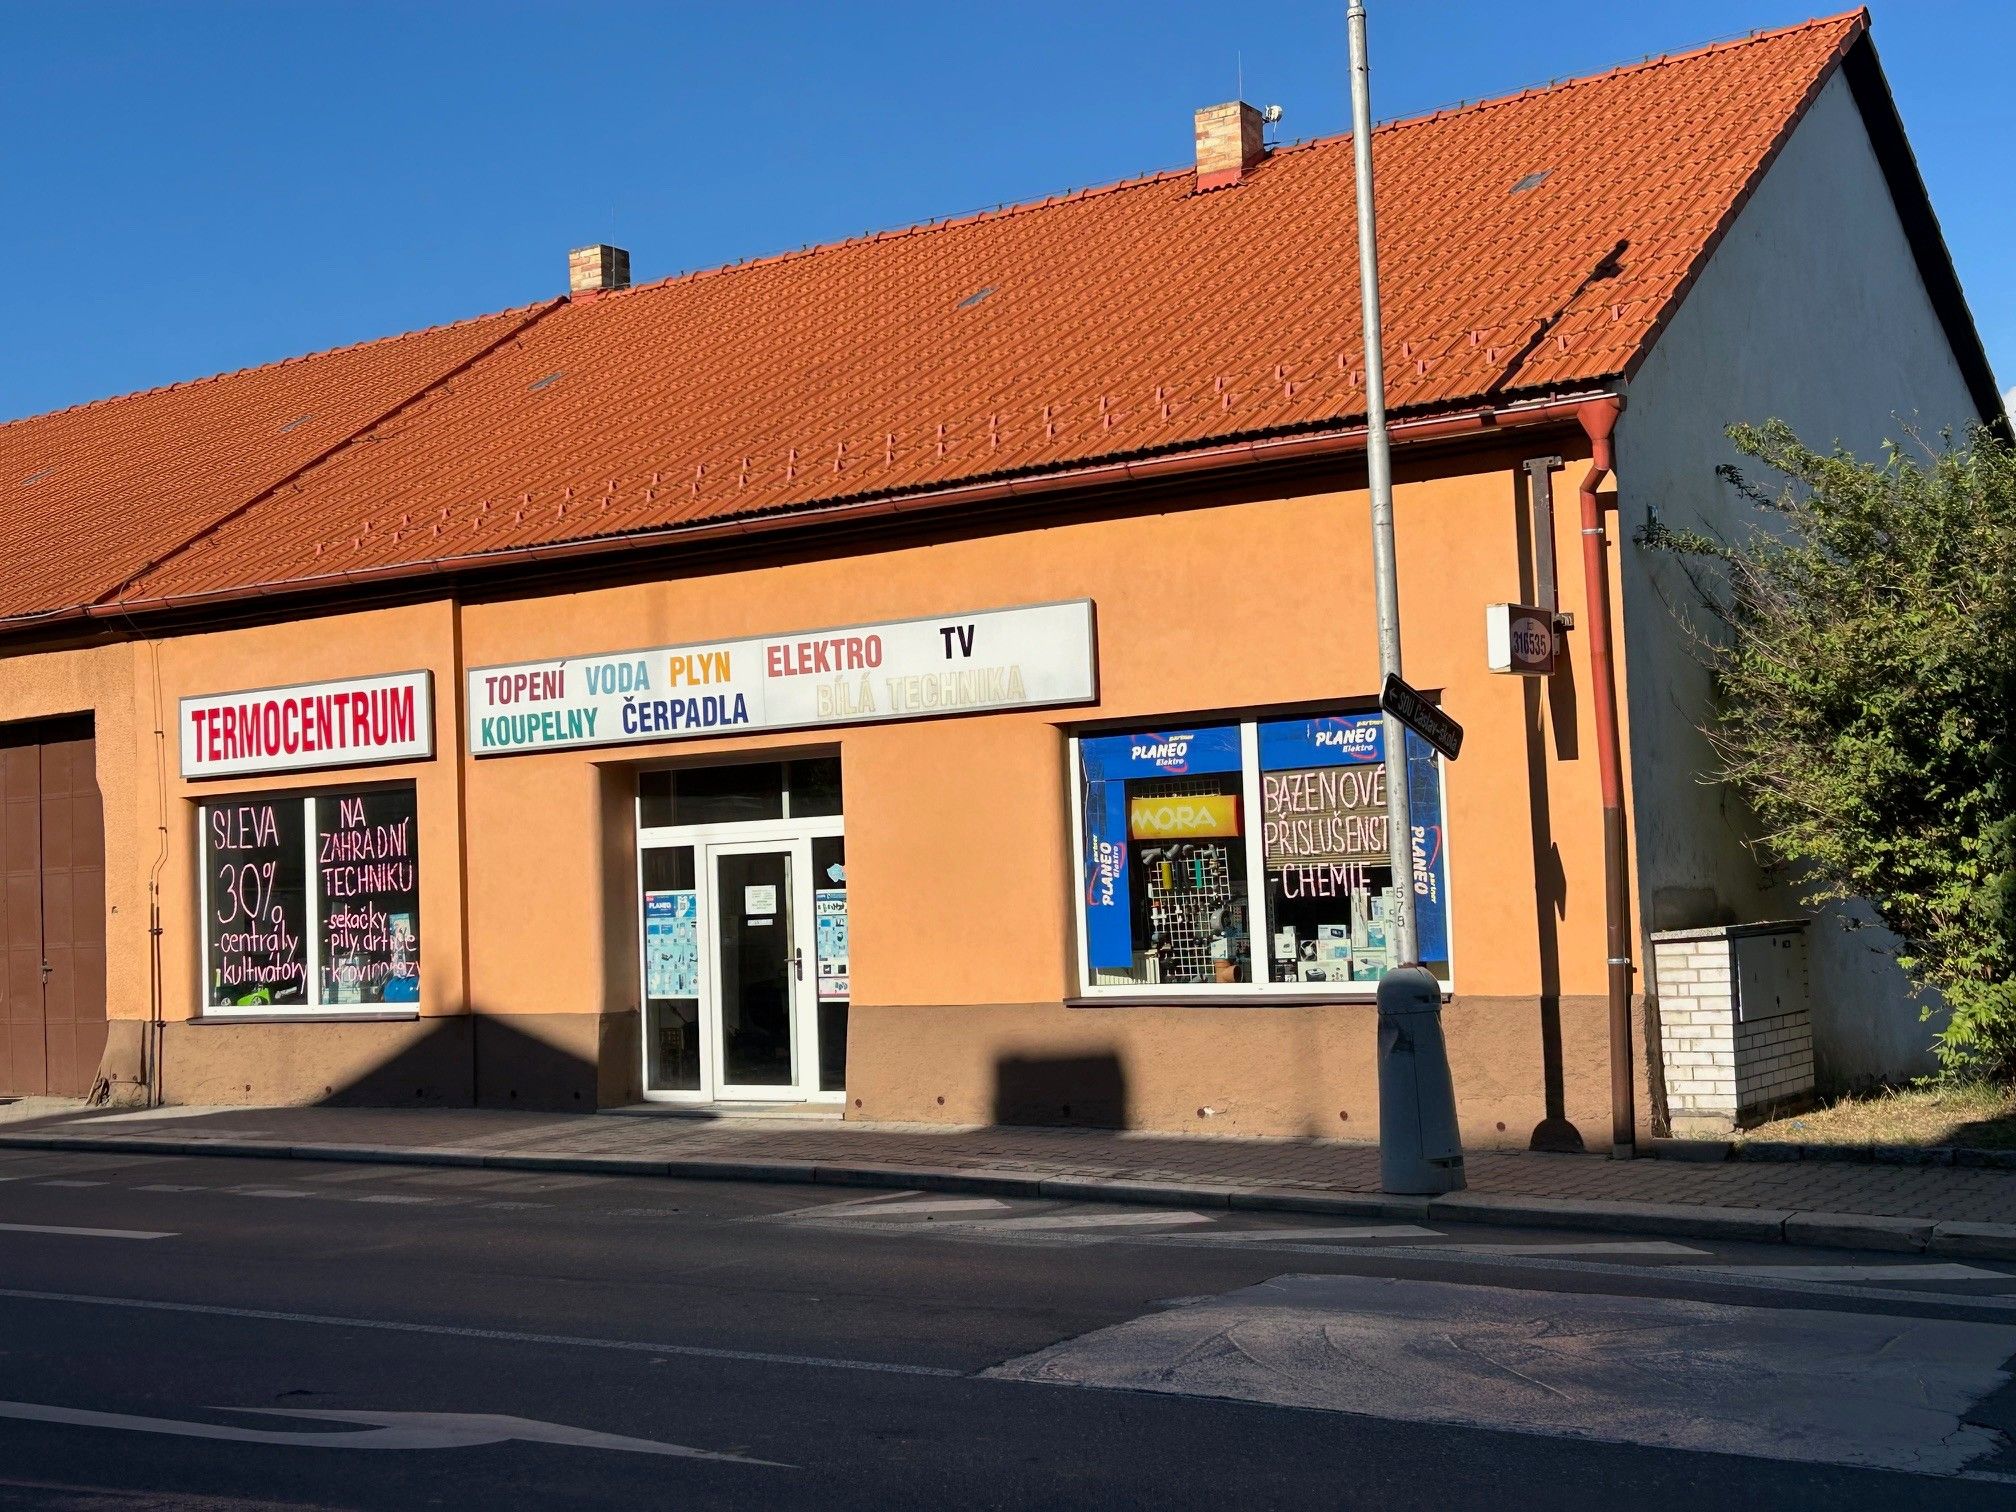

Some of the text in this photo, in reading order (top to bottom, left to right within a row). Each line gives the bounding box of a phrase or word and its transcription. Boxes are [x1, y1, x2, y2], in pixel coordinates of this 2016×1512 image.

[485, 624, 975, 705] TOPENÍ VODA PLYN ELEKTRO TV
[1513, 631, 1547, 656] 316535
[191, 685, 415, 763] TERMOCENTRUM
[481, 665, 1027, 746] KOUPELNY ČERPADLA BÍLÁ TECHNIKA
[1131, 742, 1188, 760] PLANEO
[1316, 727, 1377, 747] PLANEO
[1342, 744, 1374, 753] Elektro
[1156, 757, 1185, 766] Elektro
[213, 806, 279, 849] SLEVA
[340, 797, 366, 828] NA
[1131, 806, 1217, 832] MORA
[320, 816, 409, 863] ZAHRADNÍ
[1264, 811, 1389, 858] PŘISLUŠENST
[322, 860, 413, 896] TECHNIKU
[1100, 842, 1114, 906] PLANEO
[1411, 825, 1428, 895] PLANEO
[217, 861, 283, 923] 30%
